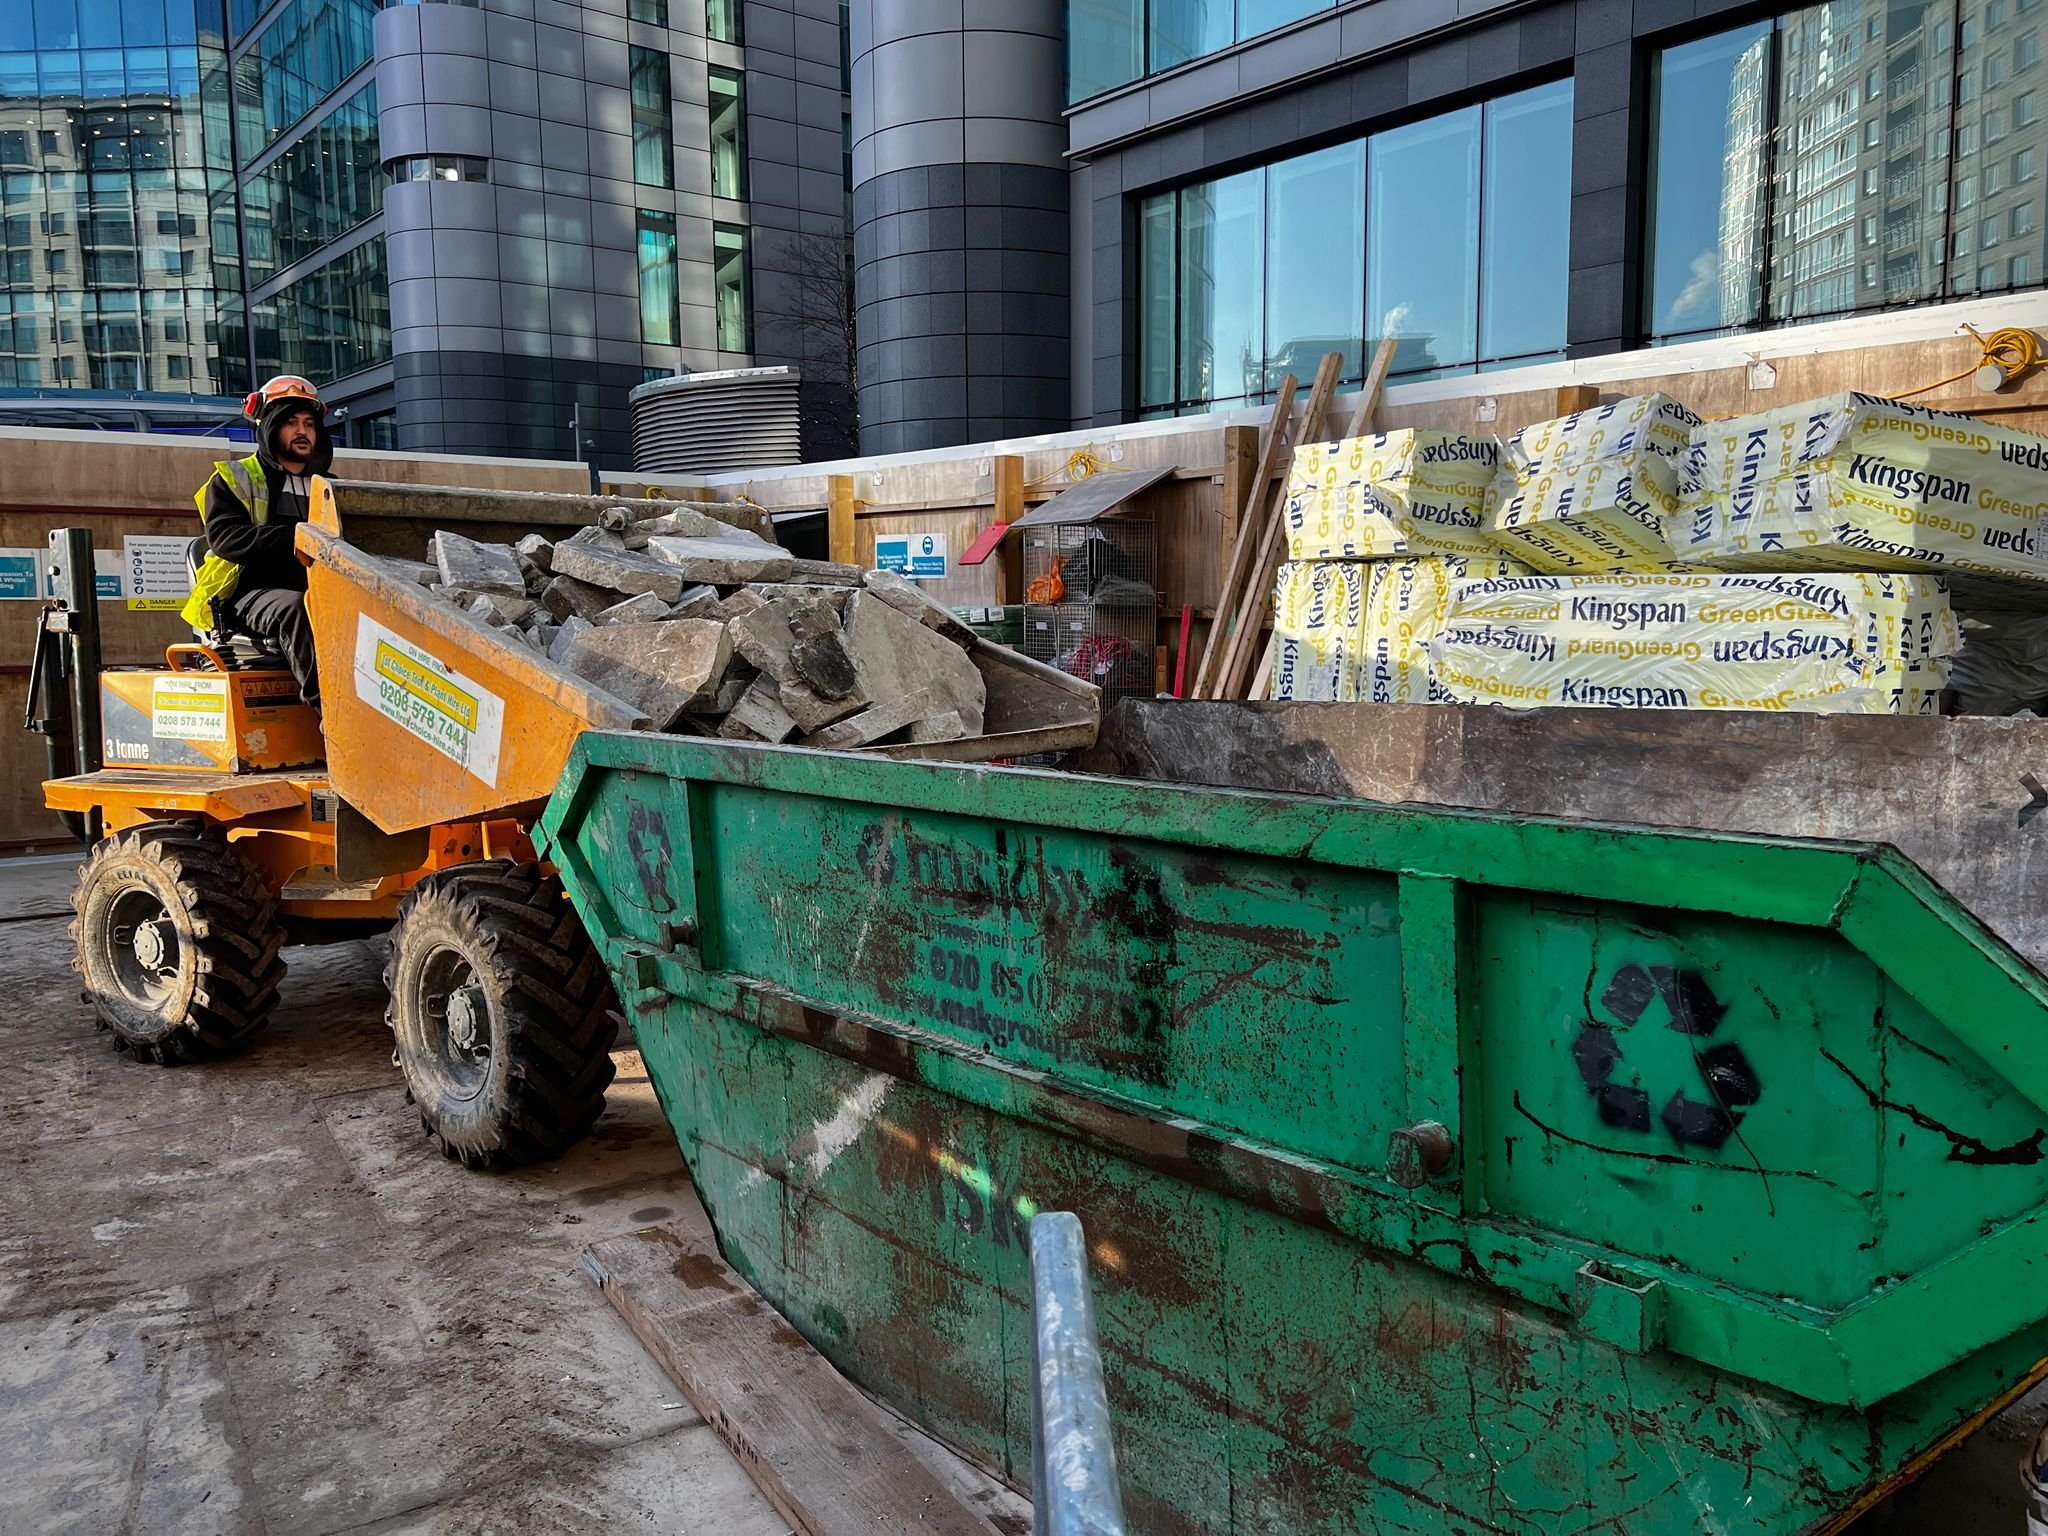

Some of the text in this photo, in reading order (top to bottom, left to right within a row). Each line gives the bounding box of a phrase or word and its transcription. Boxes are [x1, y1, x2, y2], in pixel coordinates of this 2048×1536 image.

[1863, 416, 1992, 456] GreenGuard
[1848, 453, 1971, 505] Kingspan
[1400, 517, 1492, 554] GreenGuard
[1570, 575, 1711, 589] GreenGuard
[1721, 576, 1849, 615] Kingspan
[1571, 596, 1686, 631] Kingspan
[1568, 639, 1701, 663] GreenGuard
[1713, 628, 1854, 662] Kingspan
[391, 659, 411, 679] Choice
[424, 680, 431, 692] &
[431, 684, 446, 702] Plant
[1561, 678, 1688, 709] Kingspan
[158, 715, 221, 727] 0208 578 7444
[381, 681, 468, 746] 0208 578 7444
[106, 739, 114, 759] 3
